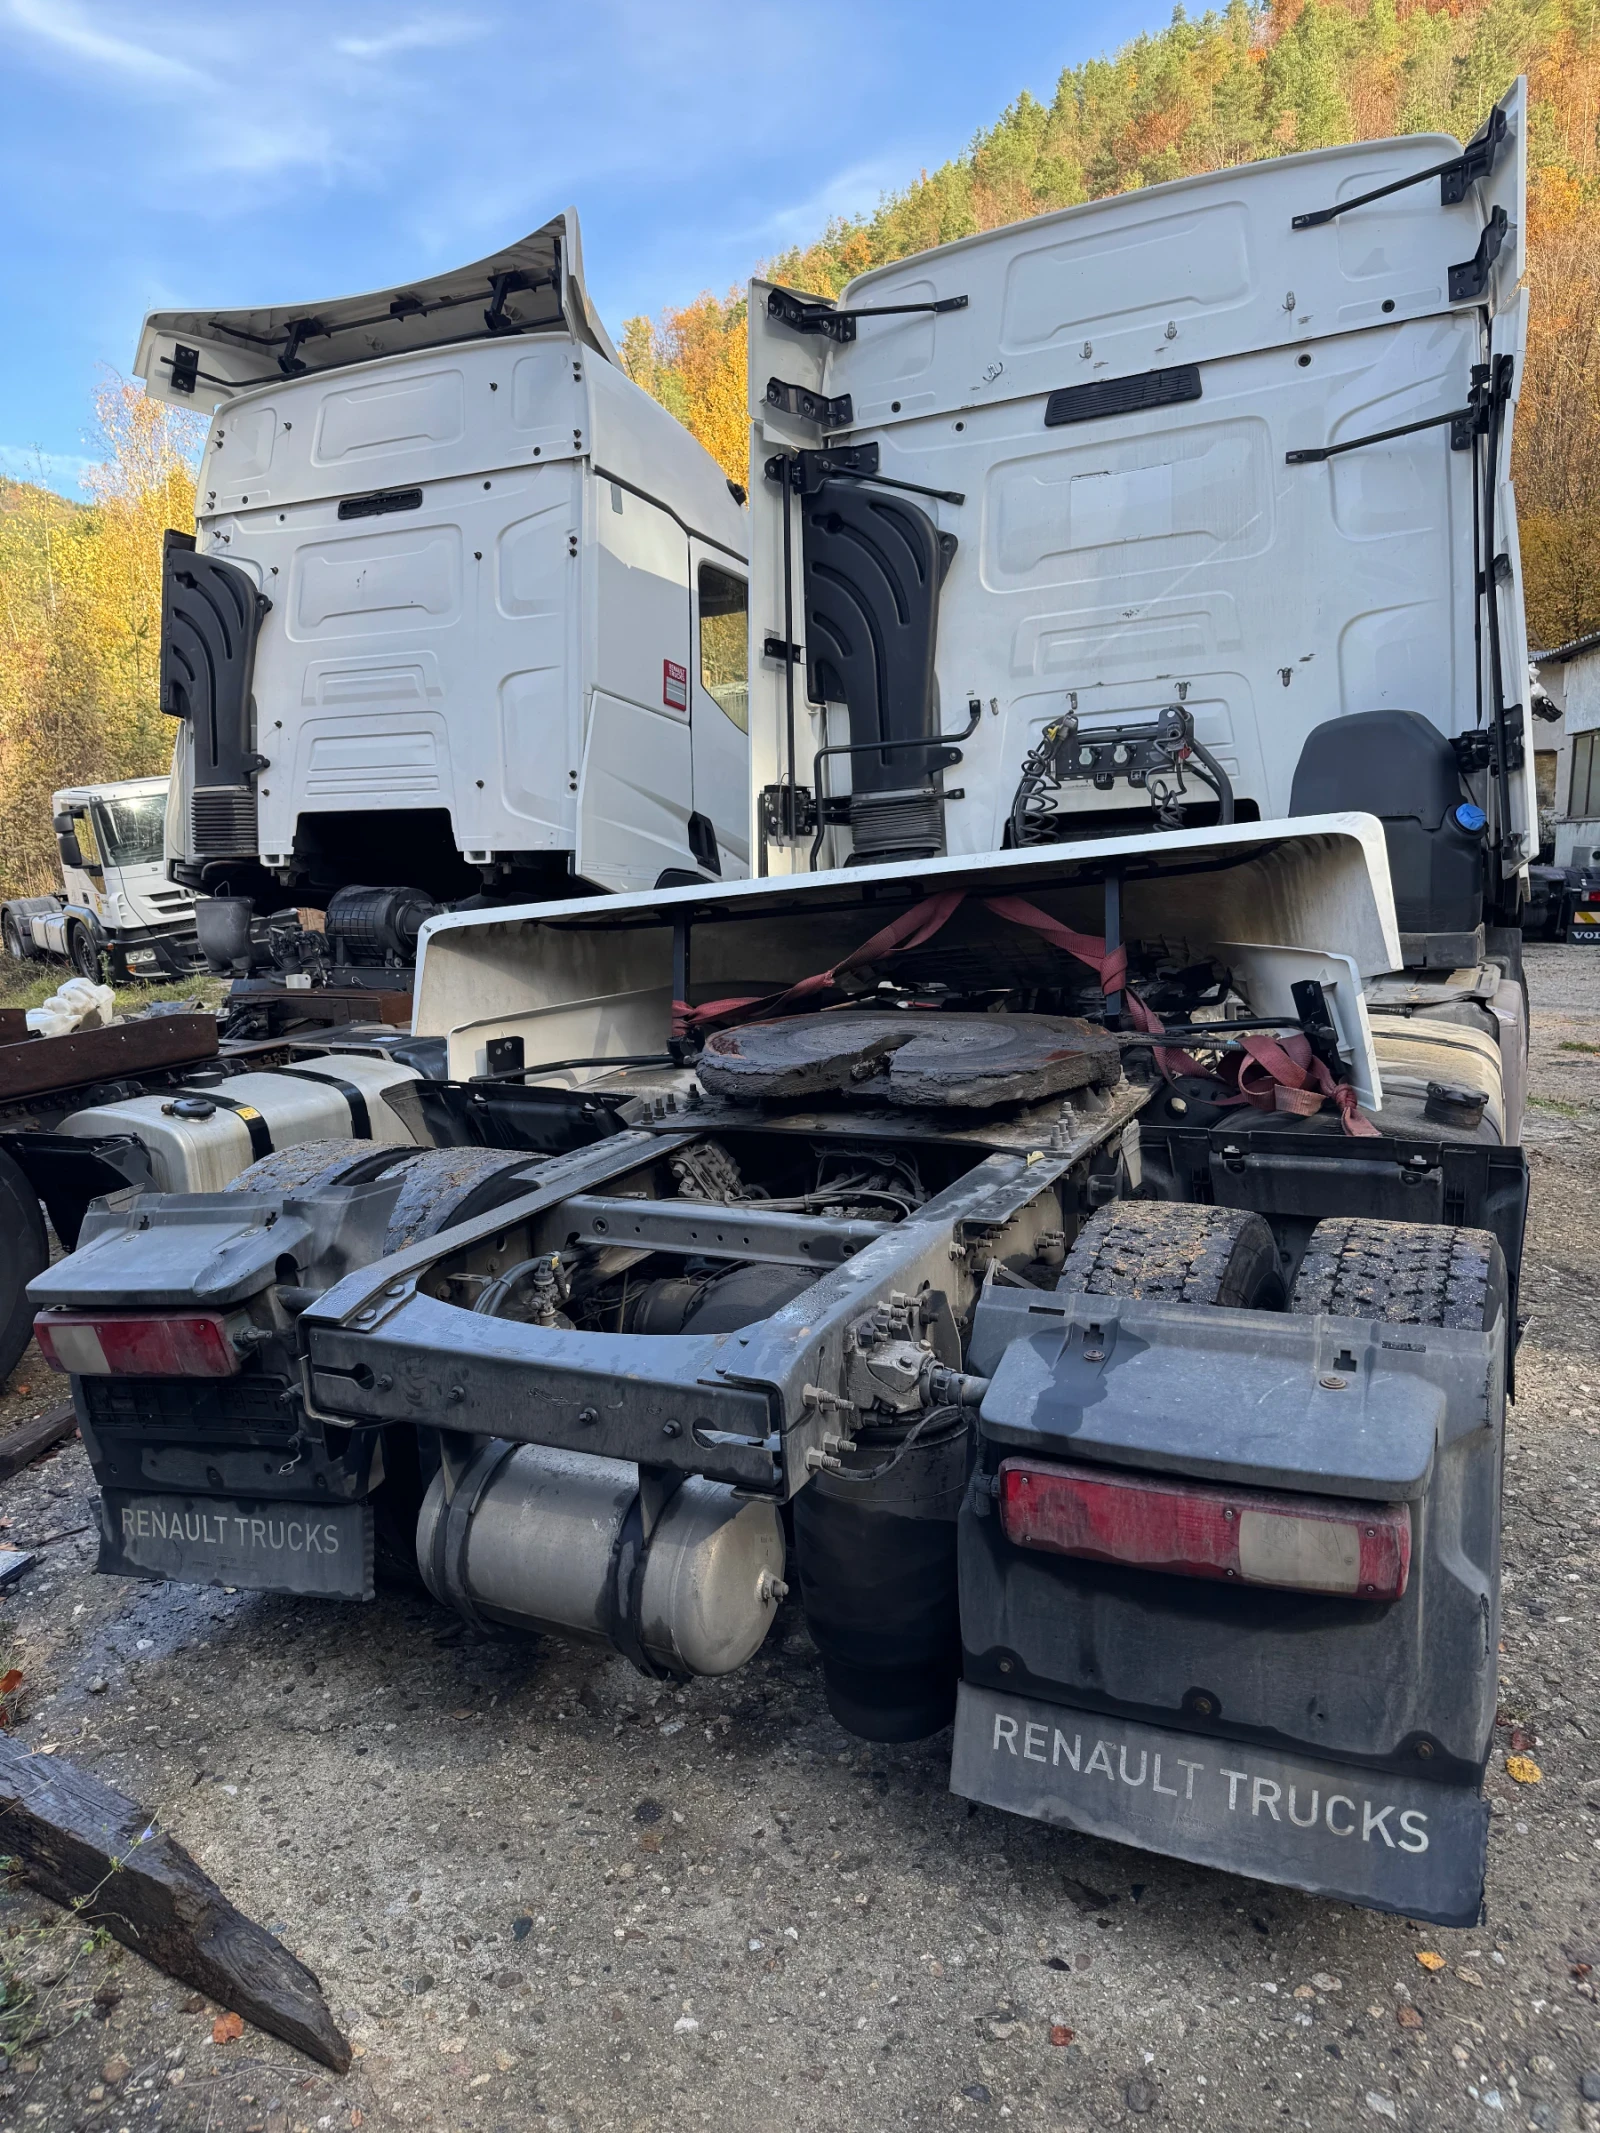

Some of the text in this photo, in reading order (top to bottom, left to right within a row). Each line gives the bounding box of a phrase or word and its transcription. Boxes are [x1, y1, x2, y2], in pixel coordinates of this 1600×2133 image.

[121, 1508, 339, 1554] RENAULT TRUCKS
[992, 1713, 1429, 1853] RENAULT TRUCKS
